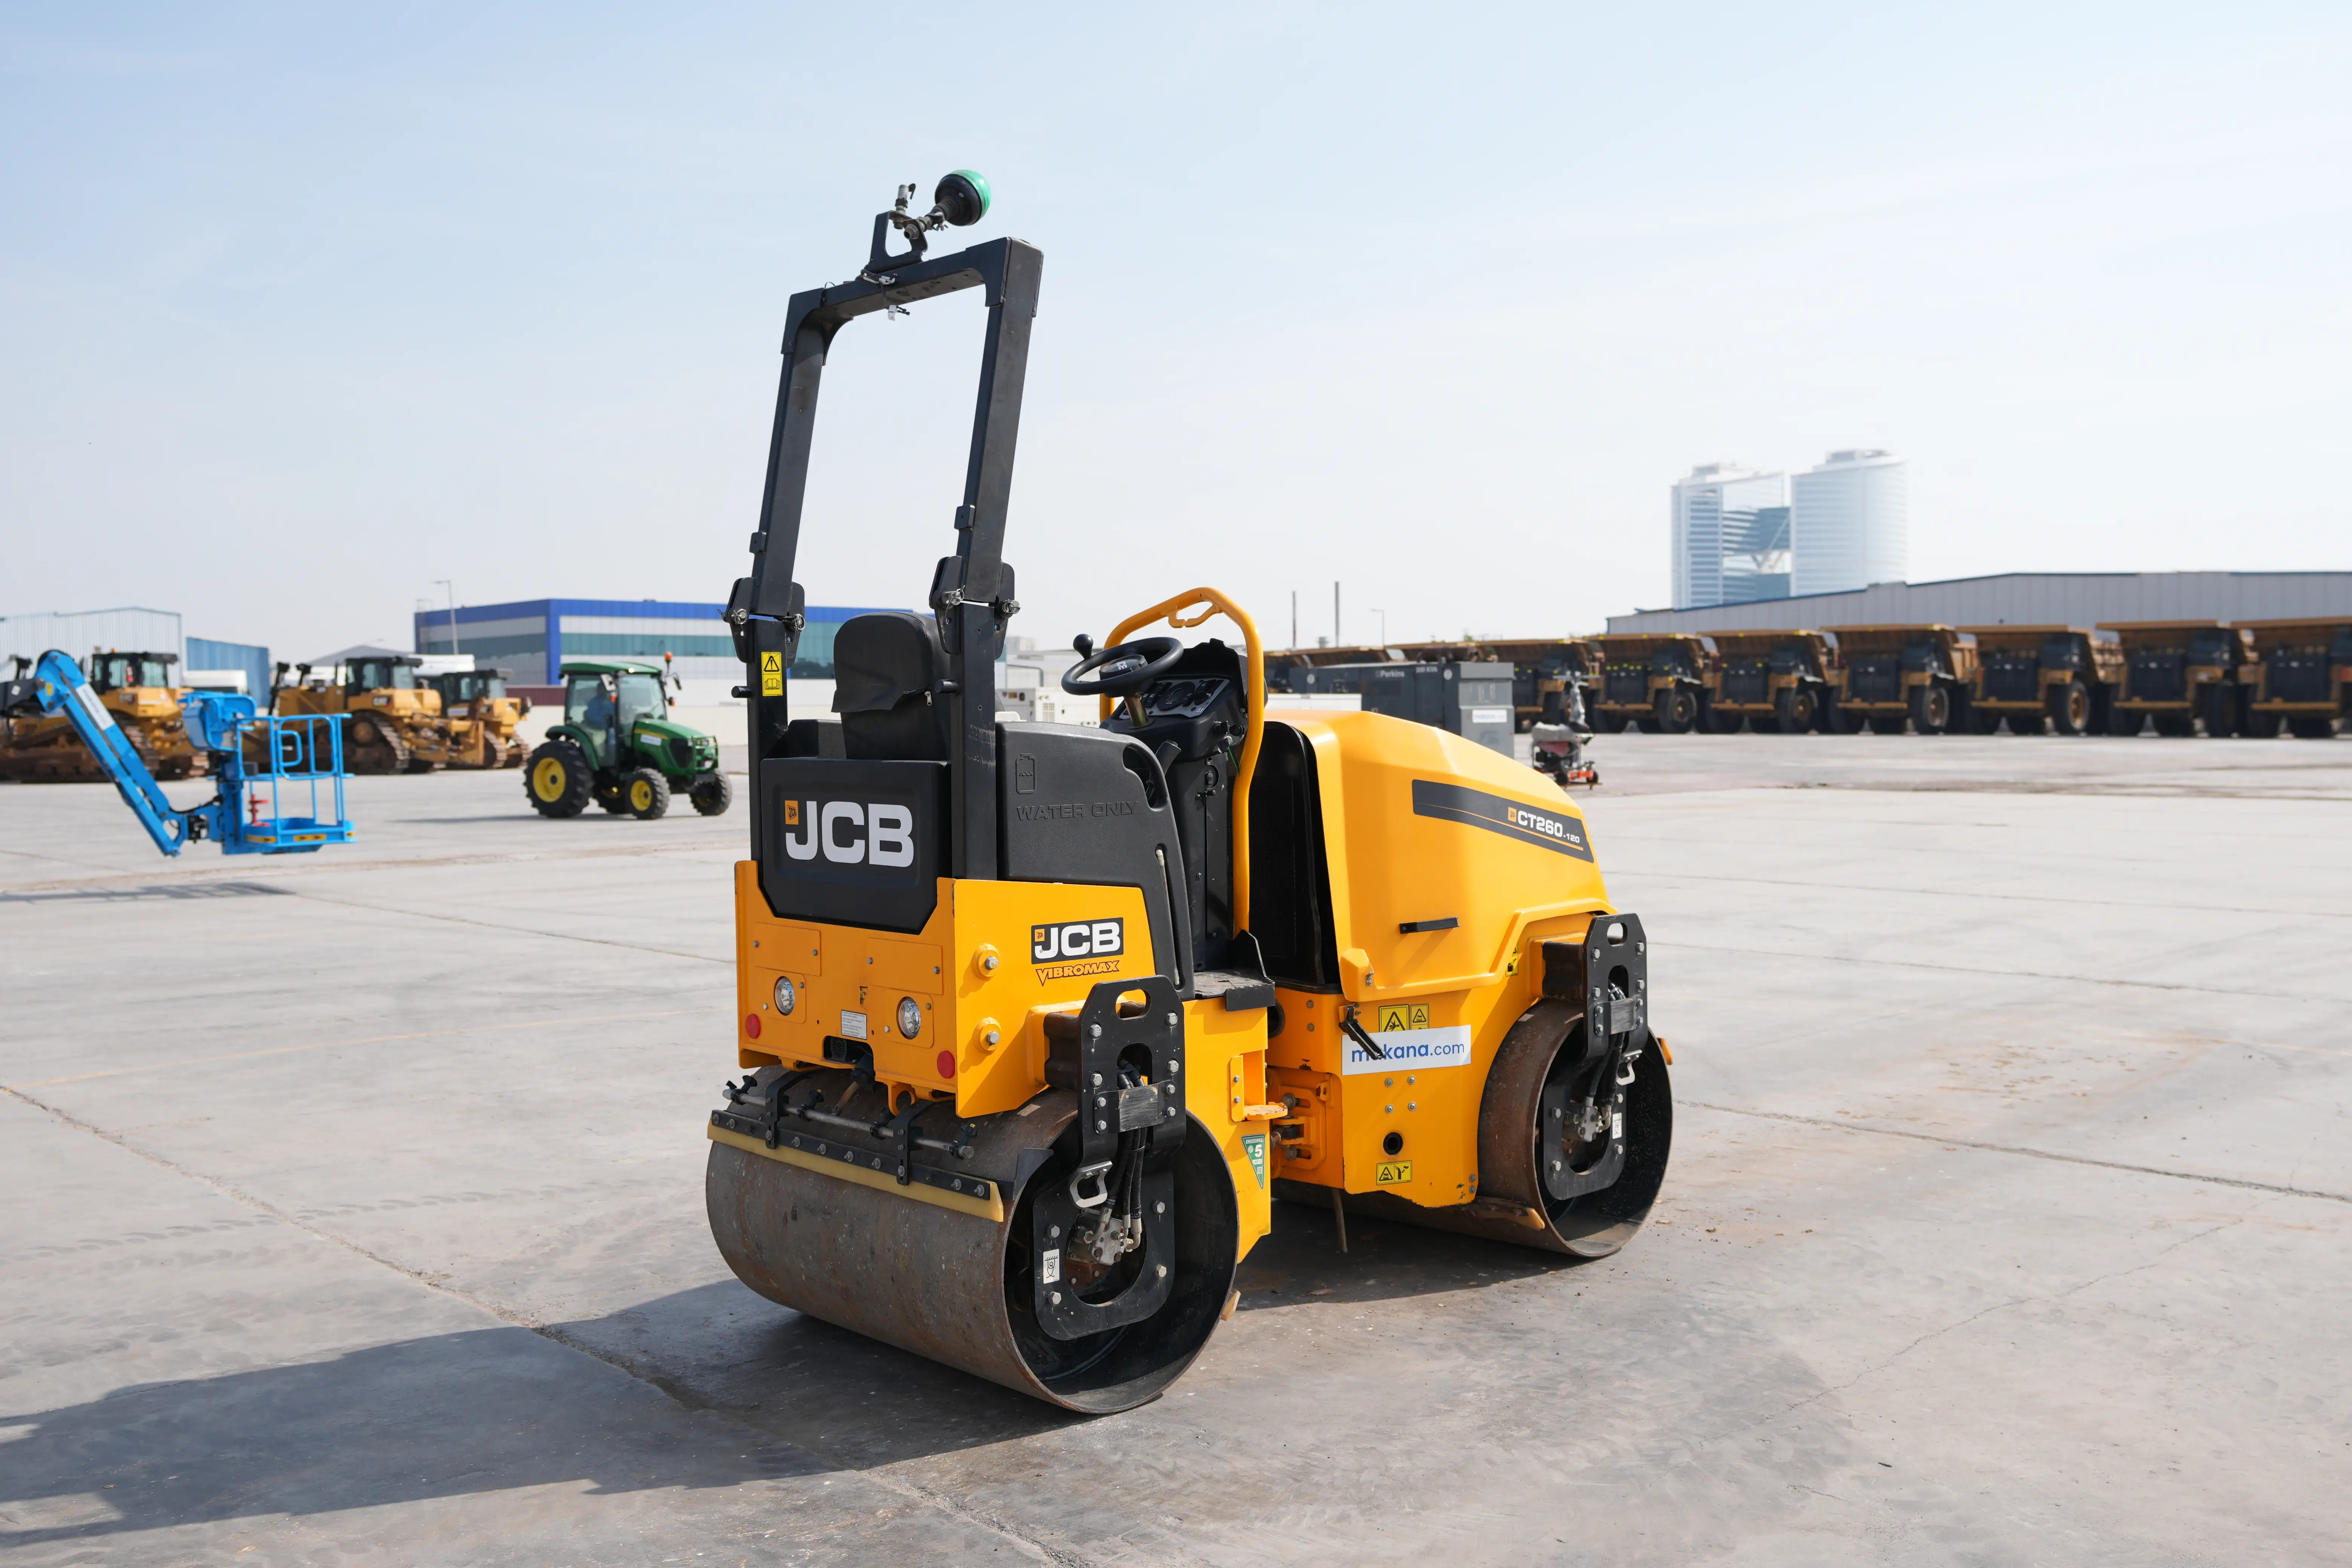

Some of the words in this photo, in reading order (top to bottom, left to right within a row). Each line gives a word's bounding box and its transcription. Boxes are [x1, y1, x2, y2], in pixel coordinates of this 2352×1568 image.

[1380, 669, 1405, 678] Perkins
[788, 807, 796, 818] JCB
[1017, 804, 1086, 821] WATER
[1092, 801, 1140, 817] ONLY
[786, 801, 914, 867] JCB
[1035, 922, 1121, 959] JCB
[1035, 960, 1120, 987] VIBROMAX
[1352, 1043, 1464, 1062] mkana.com
[1254, 1144, 1262, 1158] 5
